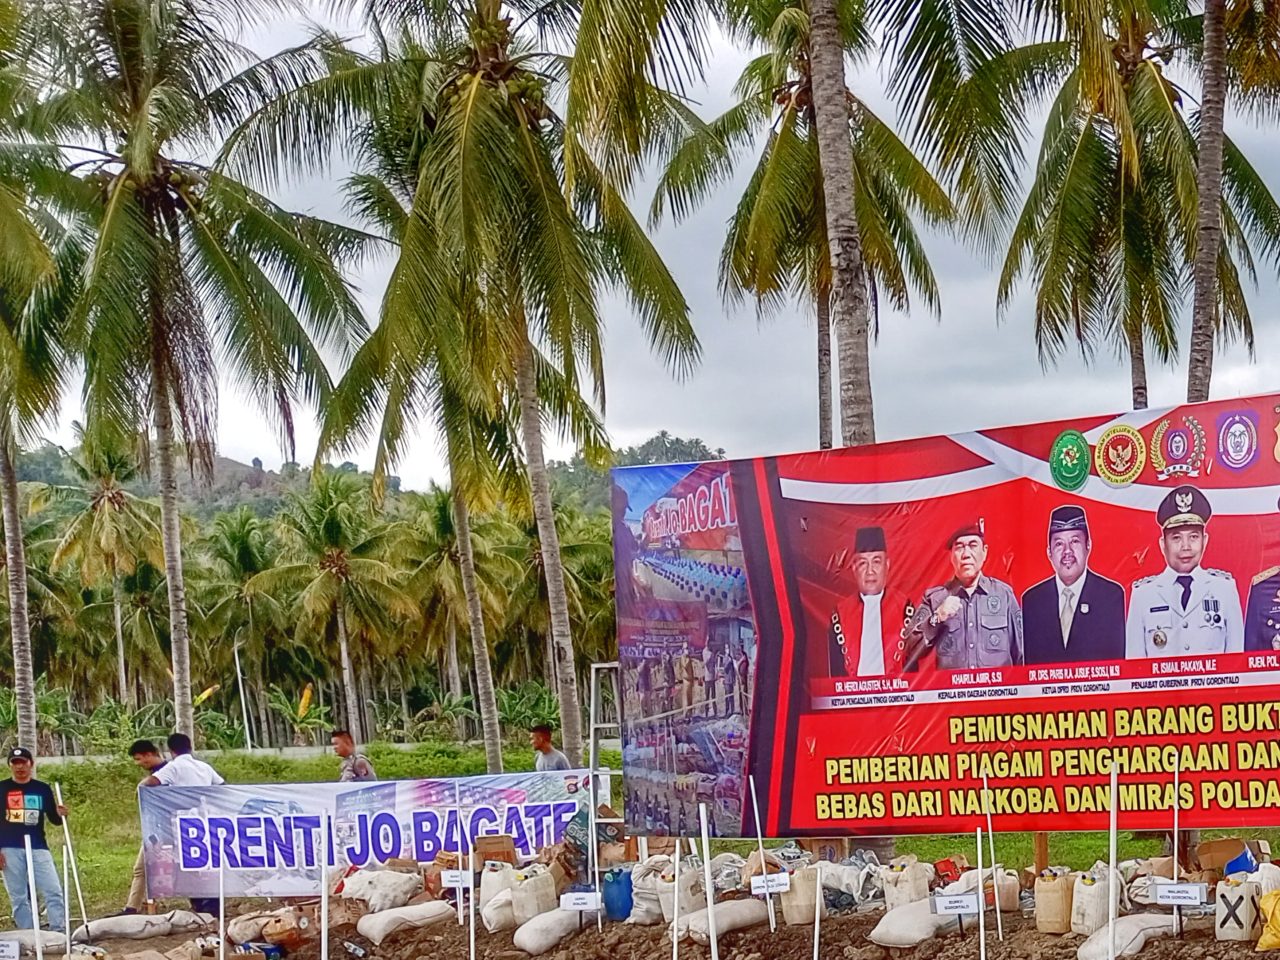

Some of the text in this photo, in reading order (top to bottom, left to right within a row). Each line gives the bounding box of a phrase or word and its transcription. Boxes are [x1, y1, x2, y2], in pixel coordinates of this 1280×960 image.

[1165, 464, 1191, 475] DPRD
[1160, 661, 1180, 674] ISMAIL
[1041, 686, 1056, 695] KETUA
[1070, 684, 1082, 693] PROV
[1083, 682, 1110, 692] GORONTALO
[1159, 679, 1189, 688] GUBERNUR
[1191, 678, 1205, 687] PROV
[1206, 676, 1240, 686] GORONTALO
[831, 694, 915, 706] KETUA PENGADILAN TINGGI GORONTALO
[937, 691, 957, 700] KEPALA
[966, 689, 987, 698] DAERAH
[987, 687, 1018, 697] GORONTALO
[949, 709, 1108, 743] PEMUSNAHAN
[1114, 704, 1213, 737] BARANG
[825, 755, 950, 784] PEMBERIAN
[956, 749, 1043, 778] PIAGAM
[1050, 742, 1229, 776] PENGHARGAAN
[816, 791, 886, 817] BEBAS
[891, 789, 943, 816] DARI
[949, 787, 1058, 815] NARKOBA
[1064, 784, 1113, 811] DAN
[1118, 781, 1195, 810] MIRAS
[346, 802, 400, 867] JO
